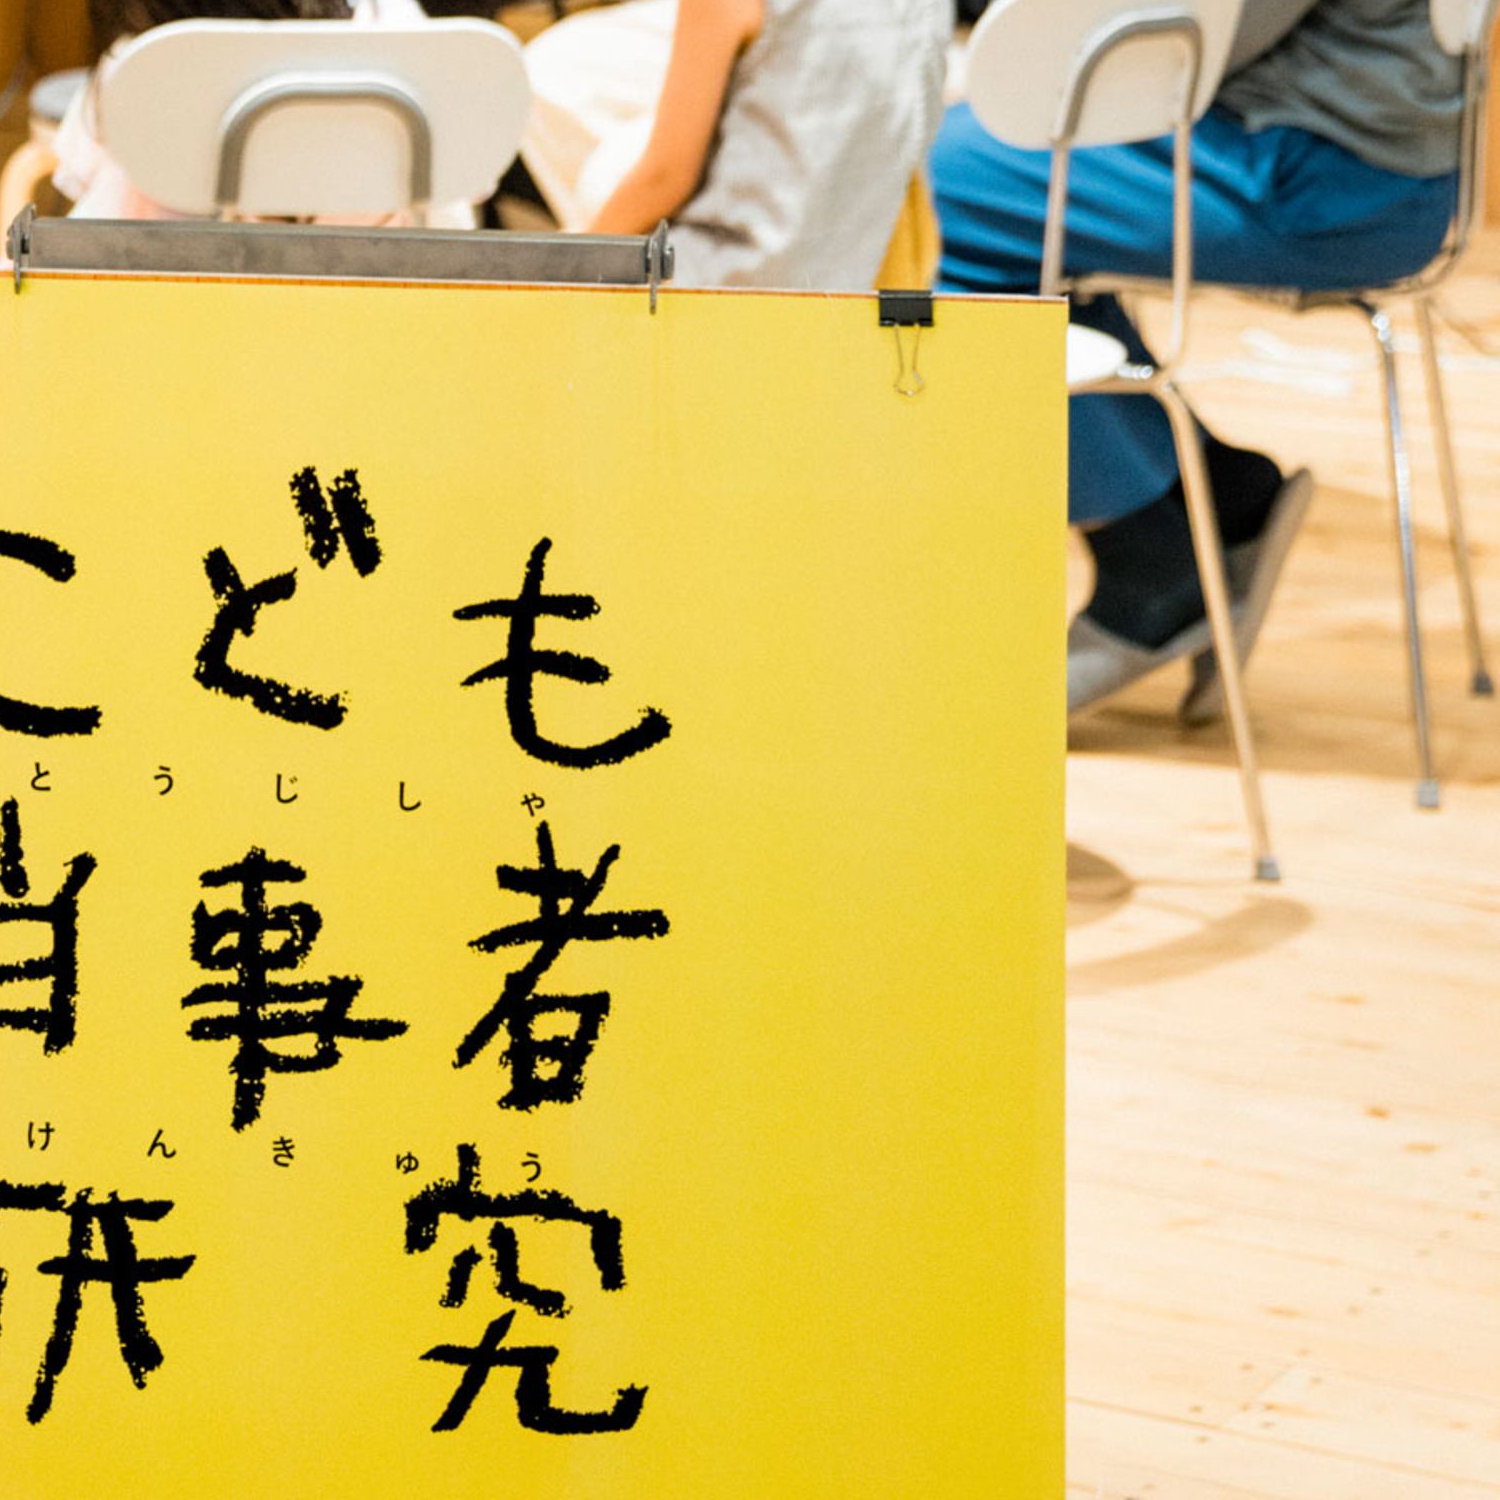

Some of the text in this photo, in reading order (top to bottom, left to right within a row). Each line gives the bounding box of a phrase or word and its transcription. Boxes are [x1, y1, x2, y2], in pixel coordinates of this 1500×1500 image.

[30, 761, 546, 818] とうじしゃ
[26, 1120, 543, 1184] けんきゅう
